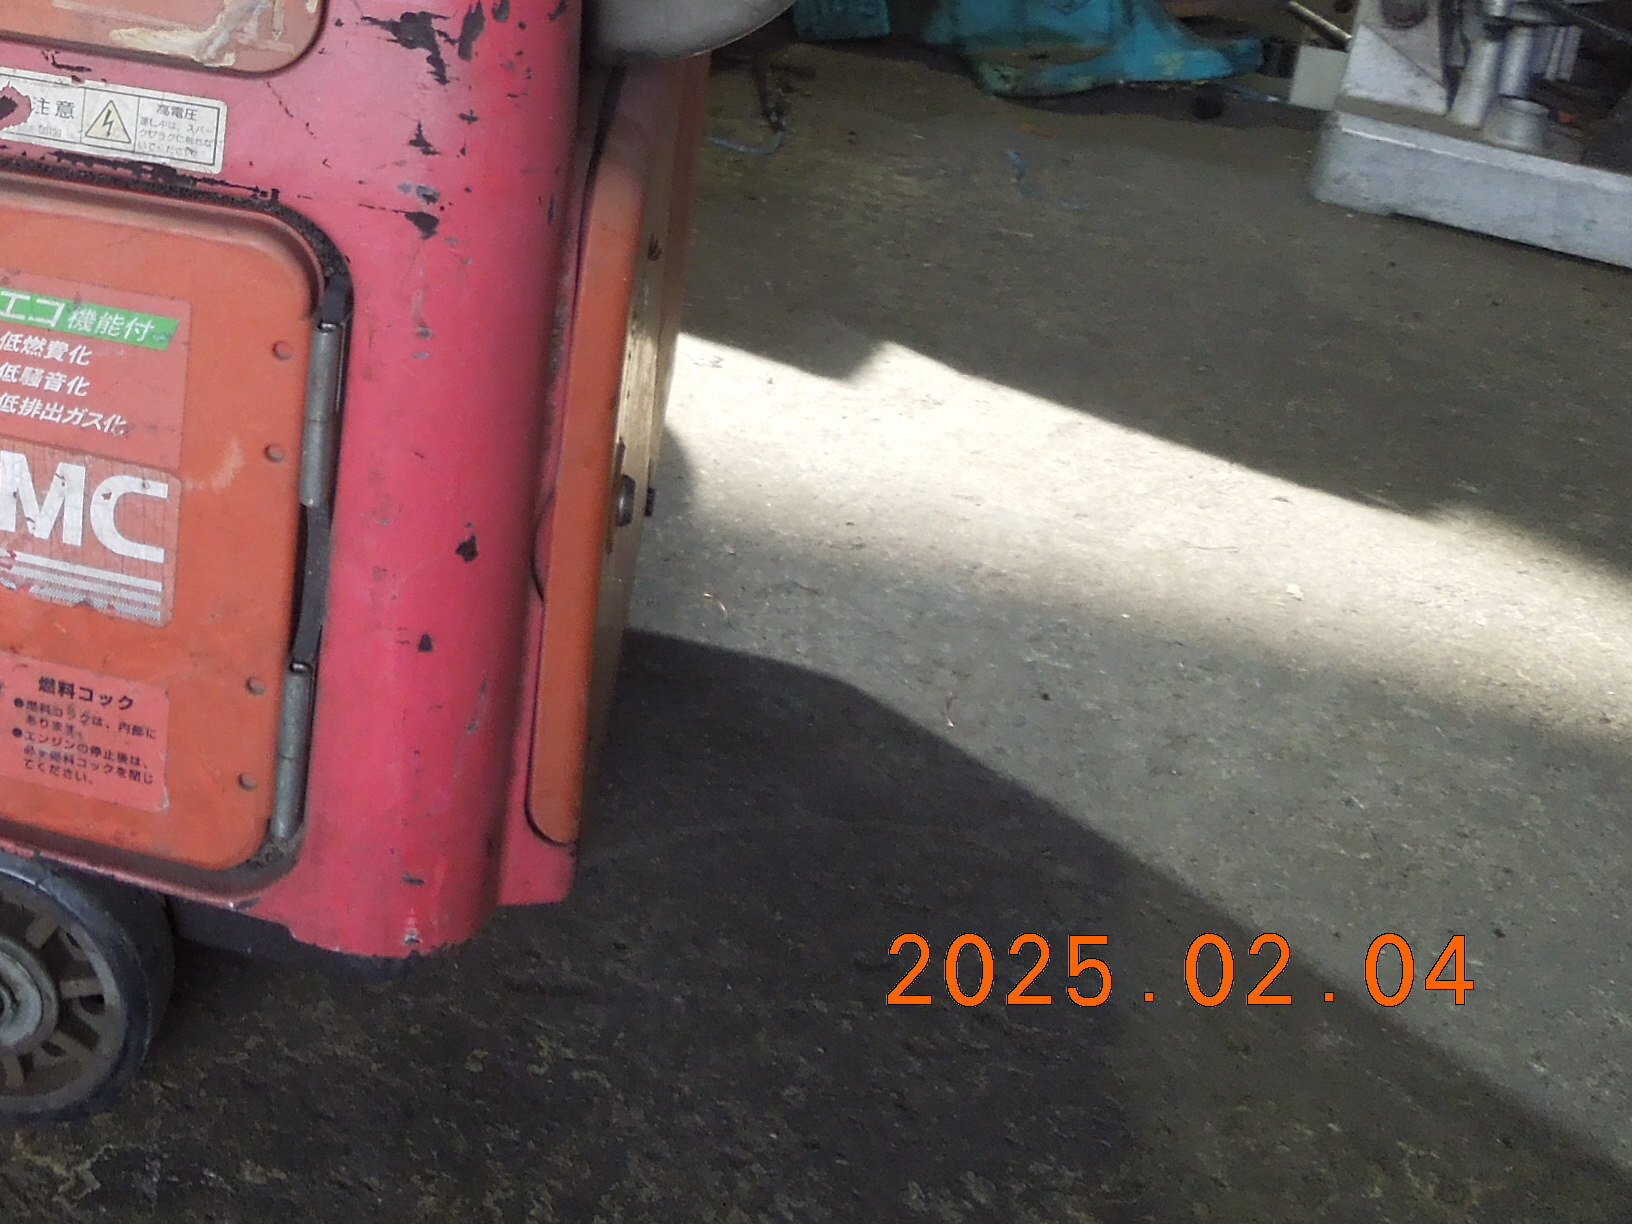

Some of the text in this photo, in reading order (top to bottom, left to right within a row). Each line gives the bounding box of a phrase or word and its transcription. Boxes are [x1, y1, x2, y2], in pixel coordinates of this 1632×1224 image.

[38, 676, 135, 711] 燃料コック
